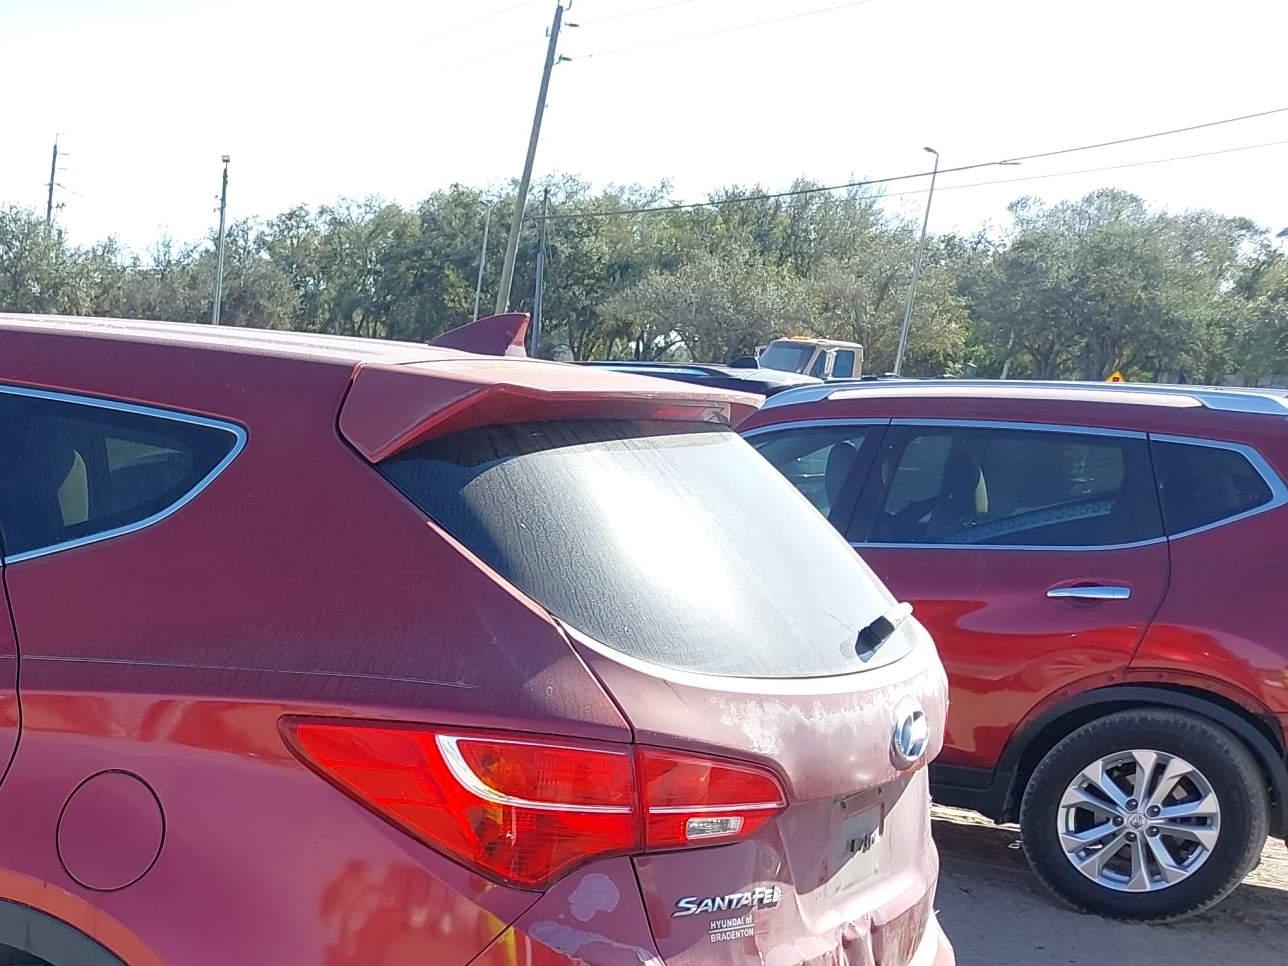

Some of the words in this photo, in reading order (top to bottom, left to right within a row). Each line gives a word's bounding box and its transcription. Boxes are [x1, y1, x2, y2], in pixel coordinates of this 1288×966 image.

[672, 891, 752, 918] SANTA
[710, 916, 744, 930] HYUNDAI
[710, 928, 754, 943] BRADENTON
